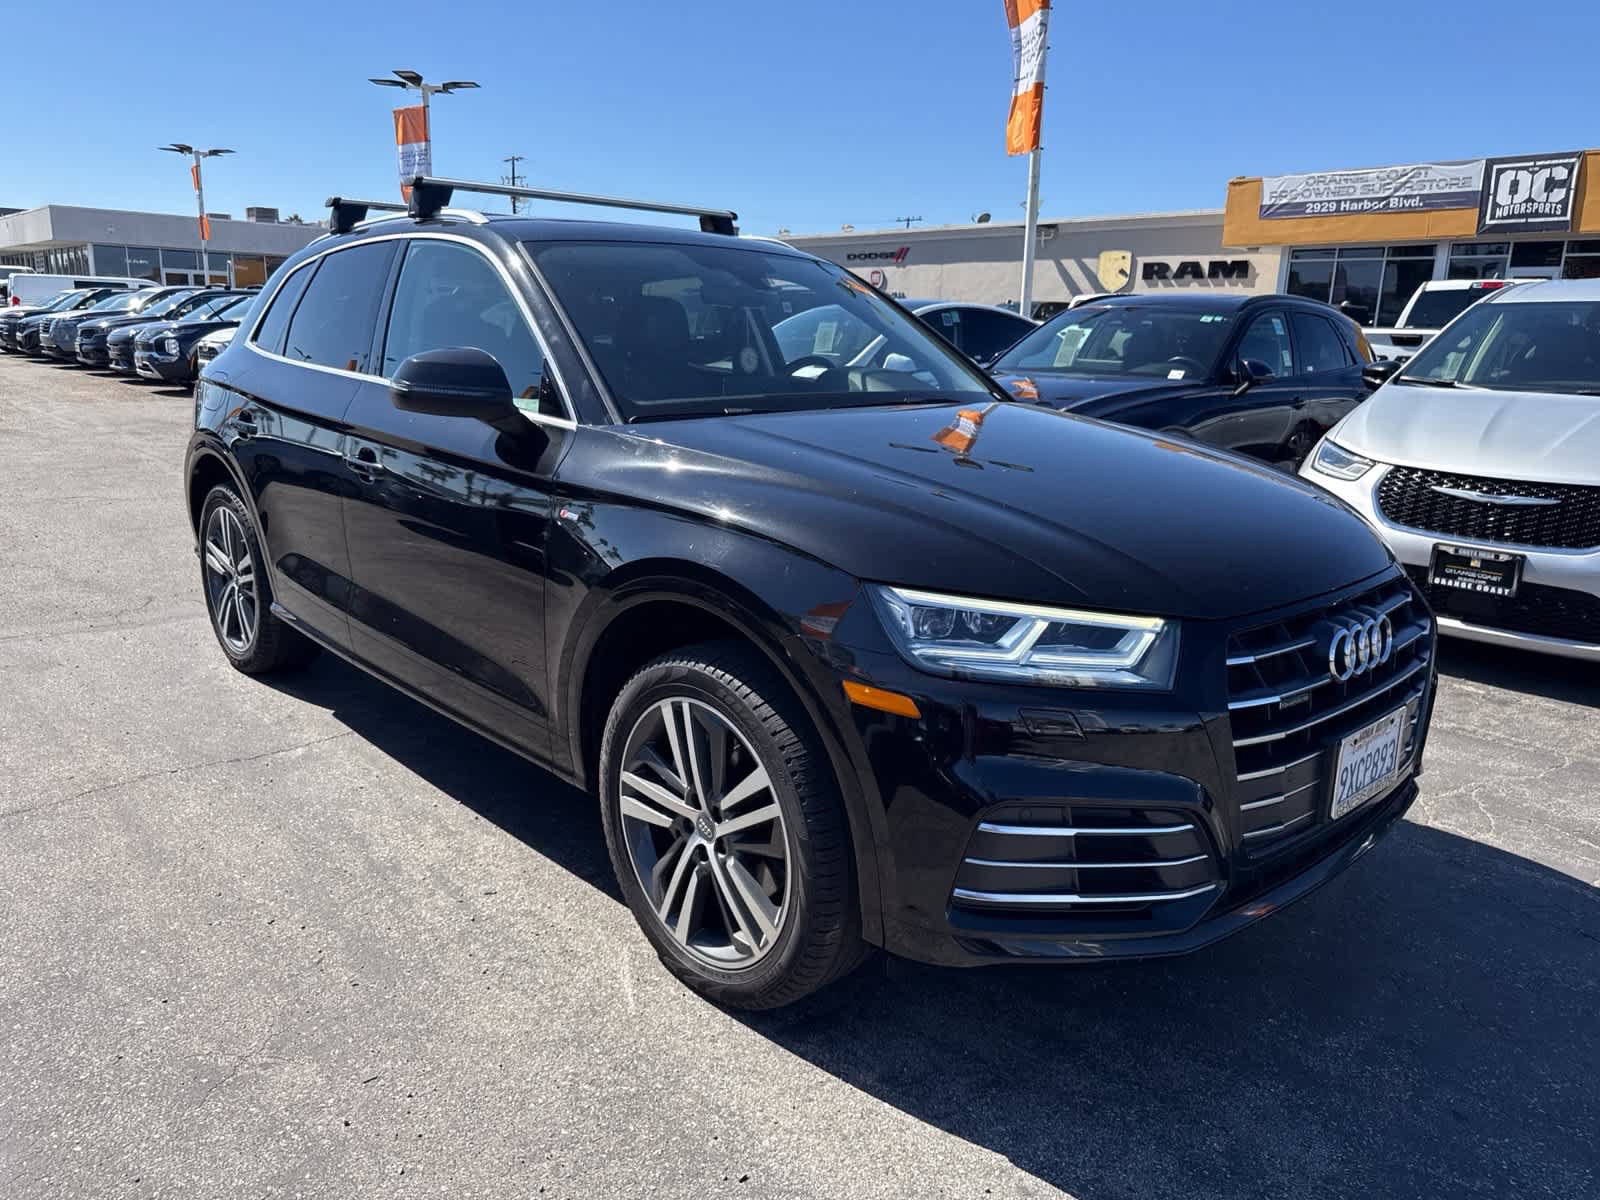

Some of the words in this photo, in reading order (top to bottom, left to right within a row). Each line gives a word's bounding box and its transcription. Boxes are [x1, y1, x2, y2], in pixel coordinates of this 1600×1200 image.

[1360, 176, 1472, 195] SUPRSTORE
[1496, 165, 1569, 206] OC
[1305, 202, 1337, 214] 2929
[1340, 199, 1386, 212] Harbor
[1389, 196, 1424, 209] Blvd.
[1495, 202, 1563, 218] MOTORSPORTS
[847, 251, 897, 261] DODGE
[1142, 260, 1249, 280] RAM
[1434, 577, 1473, 589] ORANGE
[1476, 584, 1510, 595] COAST
[1338, 741, 1396, 803] 9XCP893
